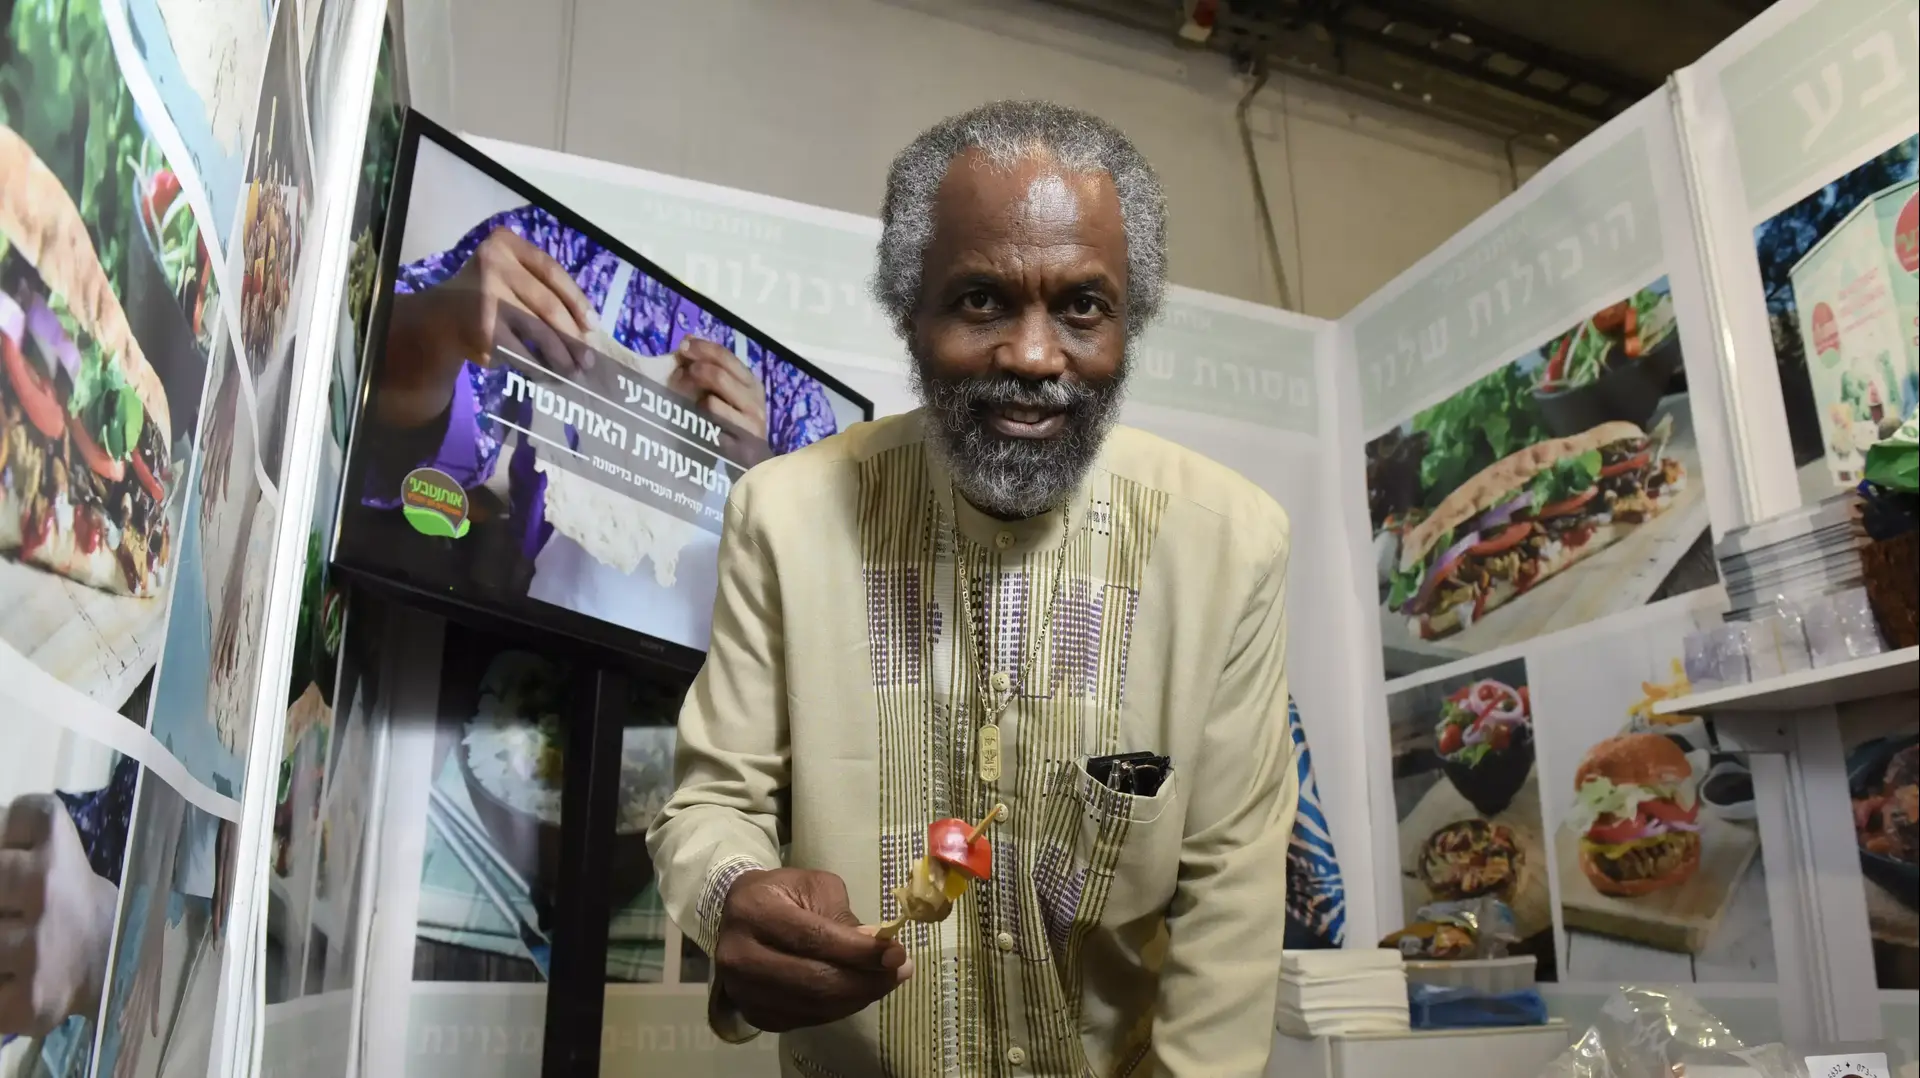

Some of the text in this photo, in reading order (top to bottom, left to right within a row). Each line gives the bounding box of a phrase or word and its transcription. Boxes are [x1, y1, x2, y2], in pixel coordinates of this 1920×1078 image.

[1792, 11, 1917, 153] בע
[1370, 201, 1634, 395] היכולות שלנו
[1193, 356, 1310, 407] מסורת
[502, 370, 731, 498] הטבעונית האותנטית
[617, 374, 721, 447] אותנטבעי
[409, 476, 463, 508] אותנטבעי
[592, 454, 632, 482] בדימונה
[634, 474, 672, 500] העבריים
[674, 492, 703, 515] קהילת
